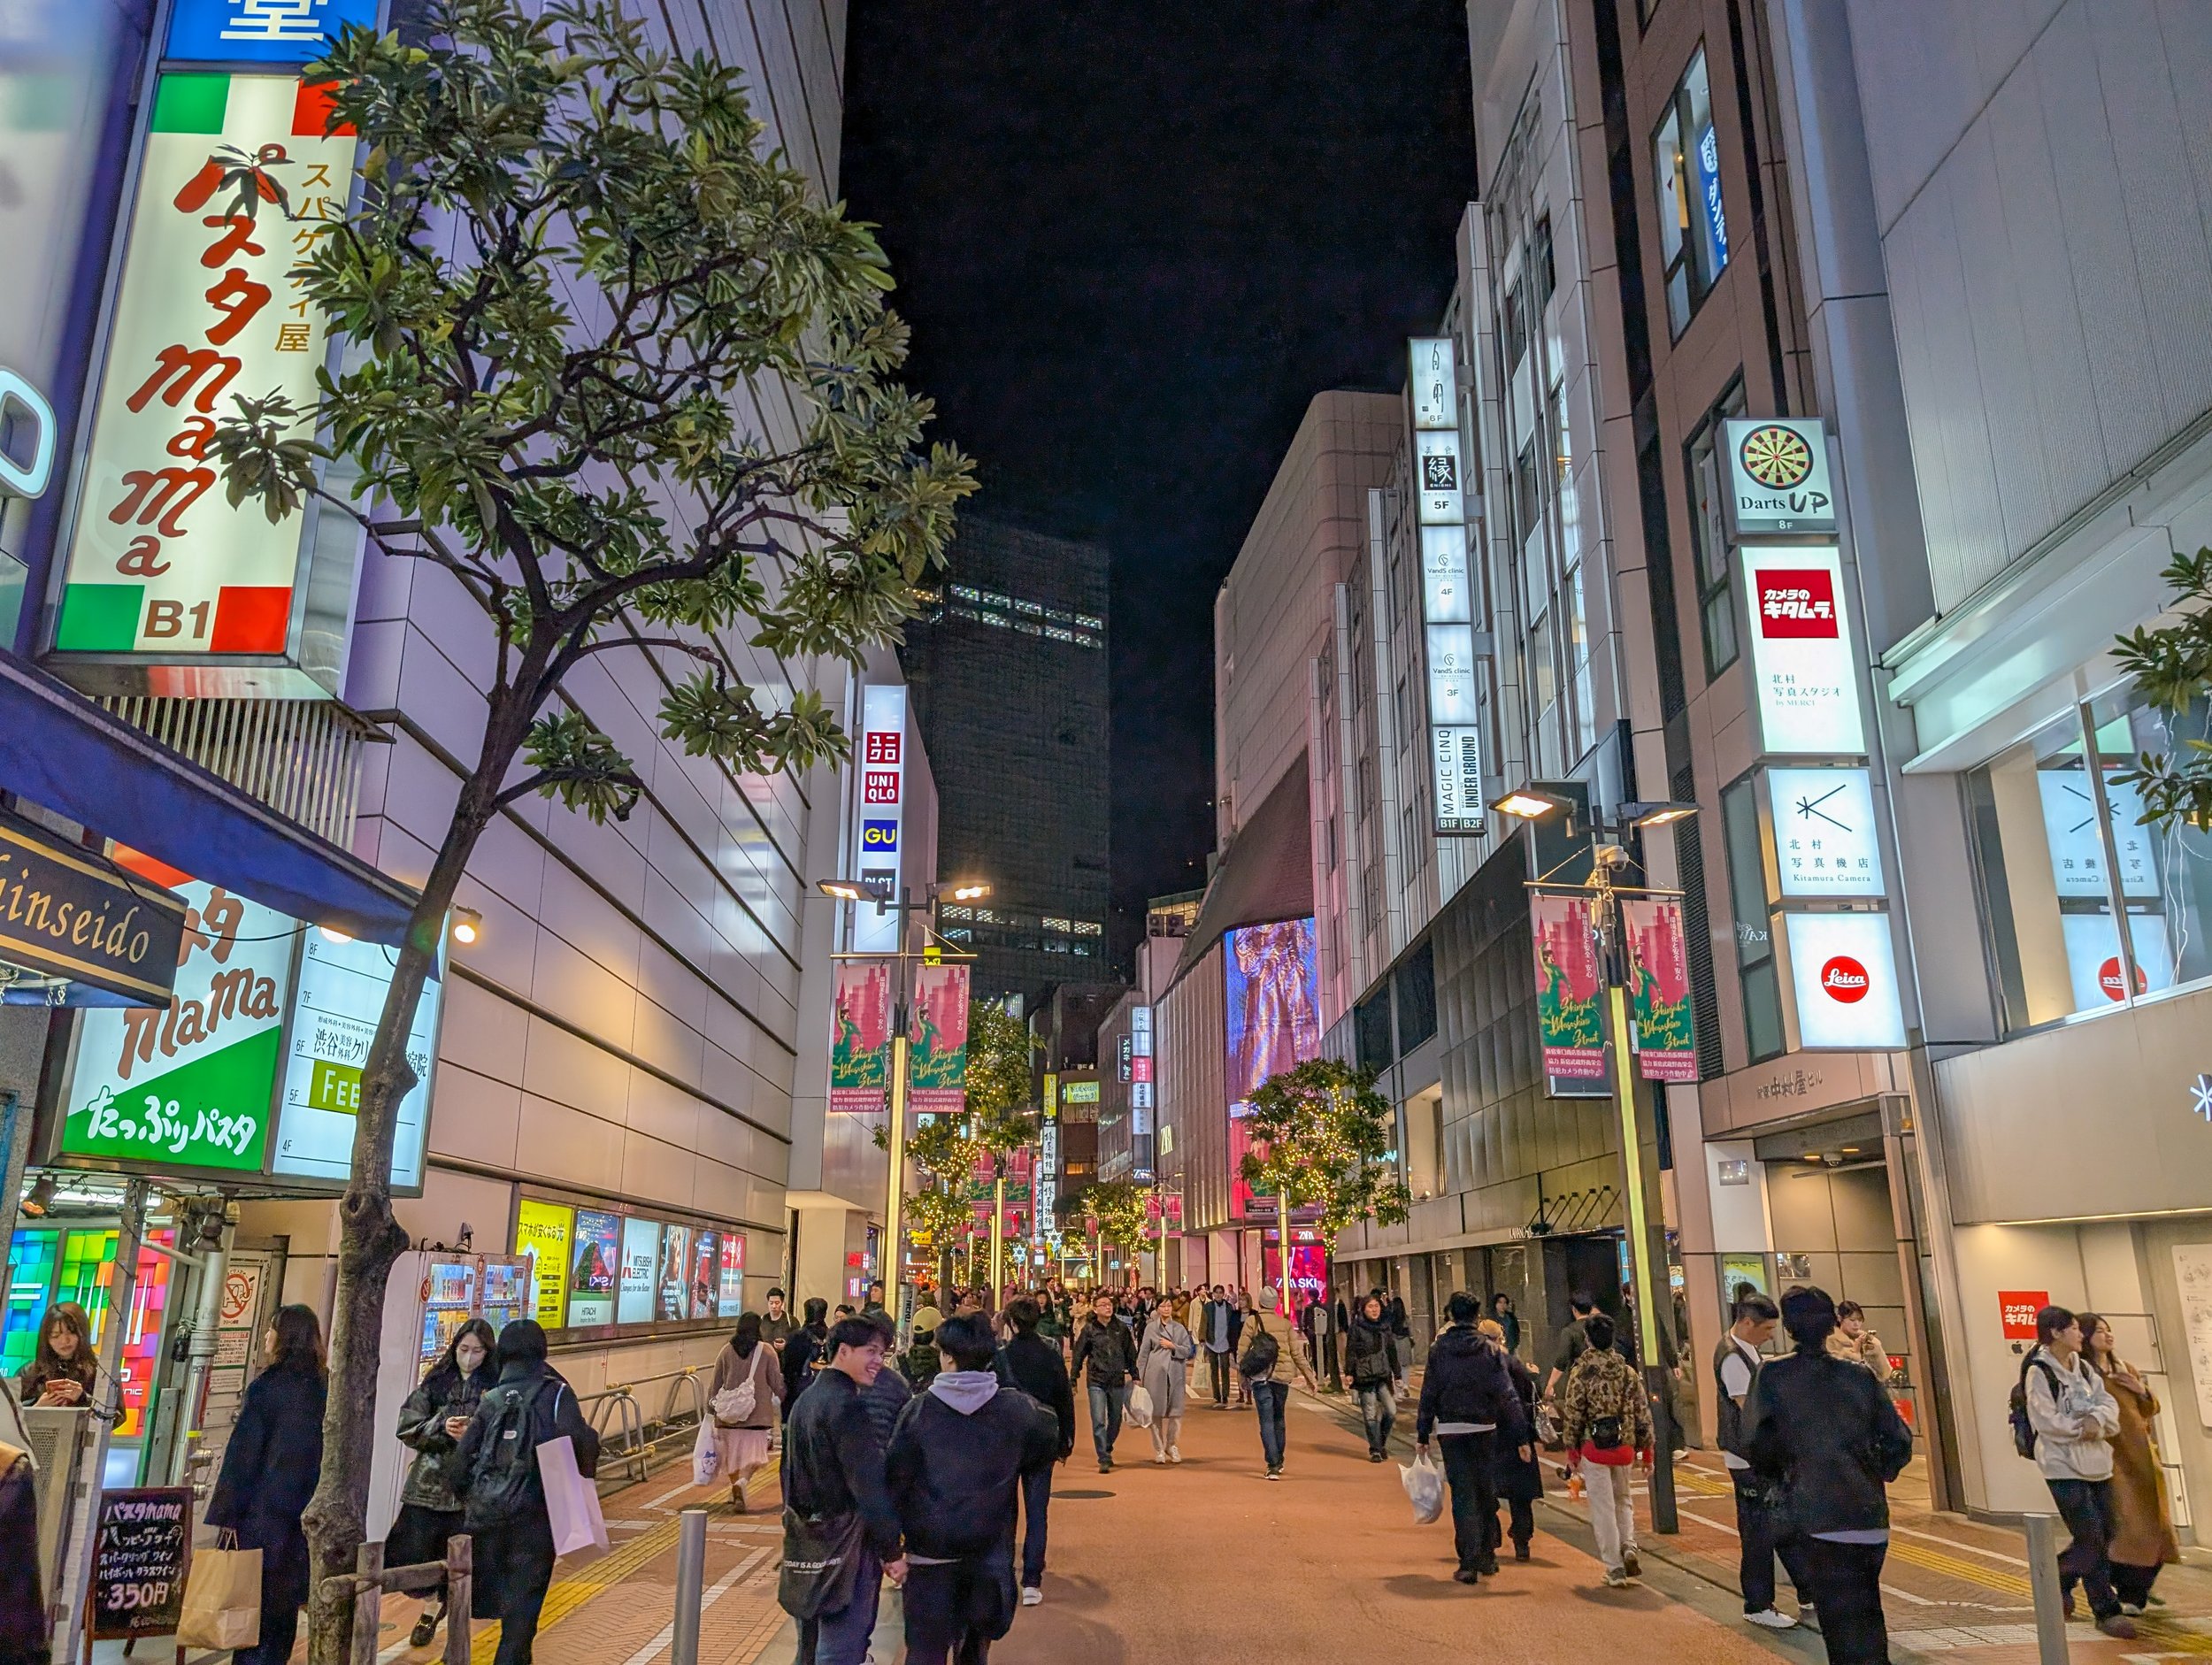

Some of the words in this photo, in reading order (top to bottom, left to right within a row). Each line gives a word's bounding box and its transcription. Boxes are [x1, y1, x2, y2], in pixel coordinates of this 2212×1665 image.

[1428, 457, 1453, 484] 縁
[1740, 496, 1786, 510] Darts
[1789, 491, 1829, 514] UP
[1778, 520, 1793, 529] 8F
[1764, 589, 1810, 601] カメラの
[1763, 602, 1831, 618] キタムラ
[143, 599, 211, 639] B1
[1773, 674, 1795, 684] 北村
[1773, 687, 1840, 697] 写真スタジオ
[871, 735, 895, 747] ユニ
[1439, 730, 1451, 763] CINQ
[869, 750, 896, 761] クロ
[1462, 736, 1478, 775] GROUND
[869, 775, 894, 786] UNI
[868, 788, 895, 801] QLO
[1440, 769, 1455, 814] MAGIC
[1463, 777, 1479, 809] UNDER
[1440, 818, 1458, 828] B1F
[1463, 818, 1482, 828] B2F
[864, 827, 896, 844] GU
[1789, 839, 1821, 849] 北村
[1792, 857, 1869, 868] 写真機店
[309, 943, 319, 955] 8F
[1824, 968, 1867, 988] Leica
[303, 991, 311, 1003] 7F
[296, 1039, 305, 1051] 6F
[289, 1089, 299, 1101] 5F
[88, 1085, 257, 1155] たっぷりパスタ
[282, 1139, 292, 1153] 4F
[633, 1268, 649, 1279] ELECTRIC
[1298, 1278, 1317, 1288] SKI
[2005, 1314, 2038, 1325] キタム
[107, 1582, 170, 1611] 350円
